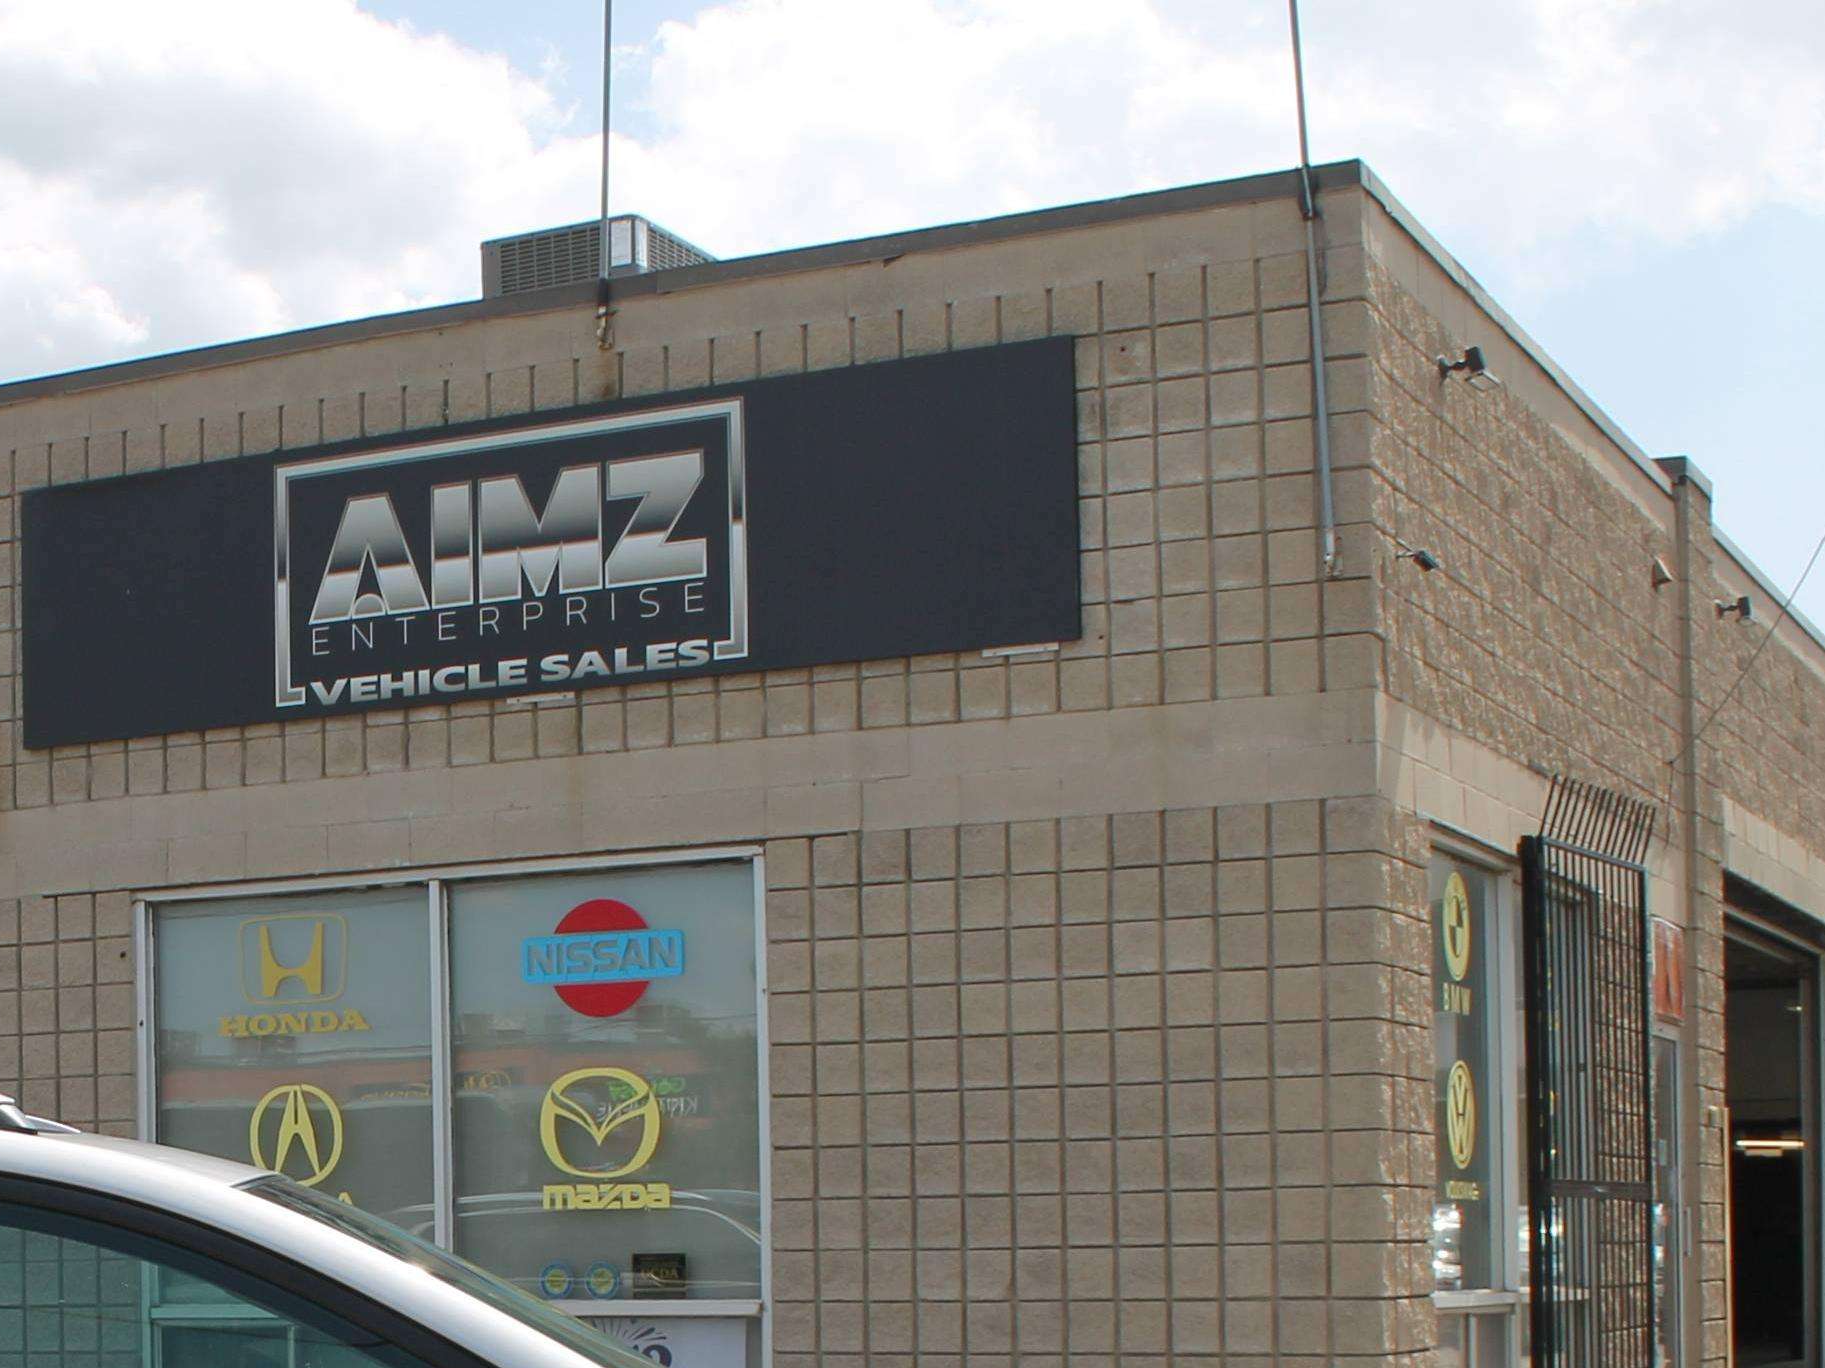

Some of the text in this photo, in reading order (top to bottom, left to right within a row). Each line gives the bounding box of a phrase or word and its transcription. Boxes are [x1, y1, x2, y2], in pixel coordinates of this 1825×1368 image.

[309, 449, 708, 625] AIMZ
[311, 582, 705, 656] ENTERPRISE
[310, 640, 711, 706] VEHICLE SALES
[528, 935, 677, 976] NISSAN
[219, 1008, 374, 1038] HONDA
